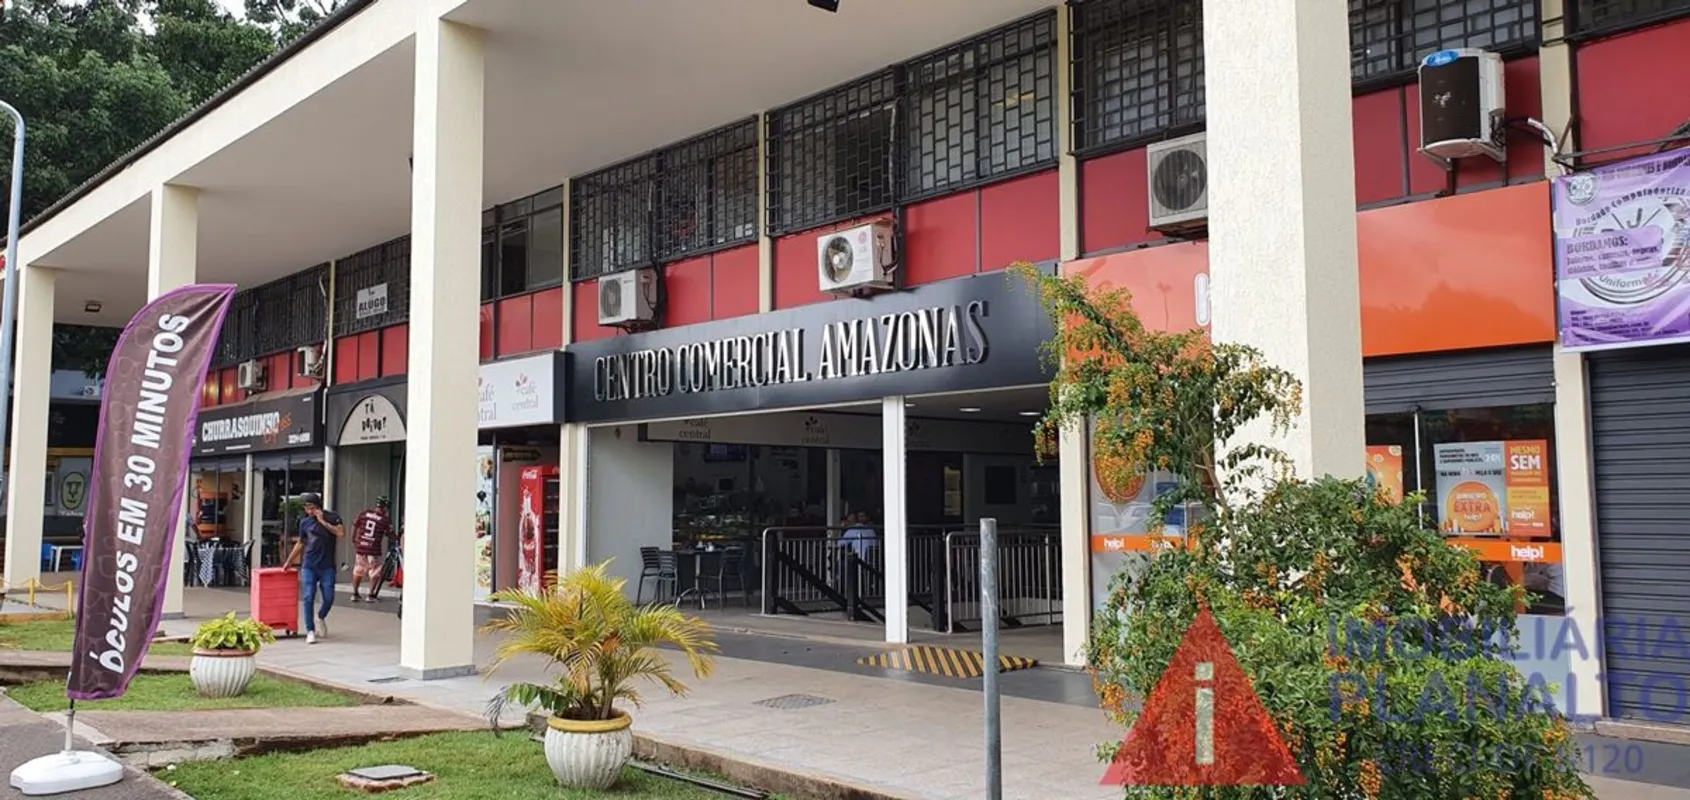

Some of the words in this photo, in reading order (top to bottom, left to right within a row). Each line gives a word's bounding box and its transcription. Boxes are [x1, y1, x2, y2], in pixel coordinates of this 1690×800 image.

[358, 296, 386, 311] ALUGO
[594, 348, 673, 402] CENTRO
[677, 328, 811, 392] COMERCIAL
[816, 300, 990, 381] AMAZONAS
[133, 313, 190, 449] MINUTOS
[479, 383, 495, 401] afé
[512, 395, 539, 411] central
[479, 402, 497, 422] tral
[202, 411, 280, 442] CHURRASQUINHO
[679, 428, 711, 439] central
[1510, 455, 1541, 470] SEM
[125, 455, 156, 492] 30
[1453, 500, 1491, 513] EXTRA
[1511, 508, 1535, 520] help!
[117, 498, 149, 546] EM
[365, 520, 376, 537] 9
[1510, 544, 1544, 560] help!
[90, 549, 139, 674] ÓCULOS
